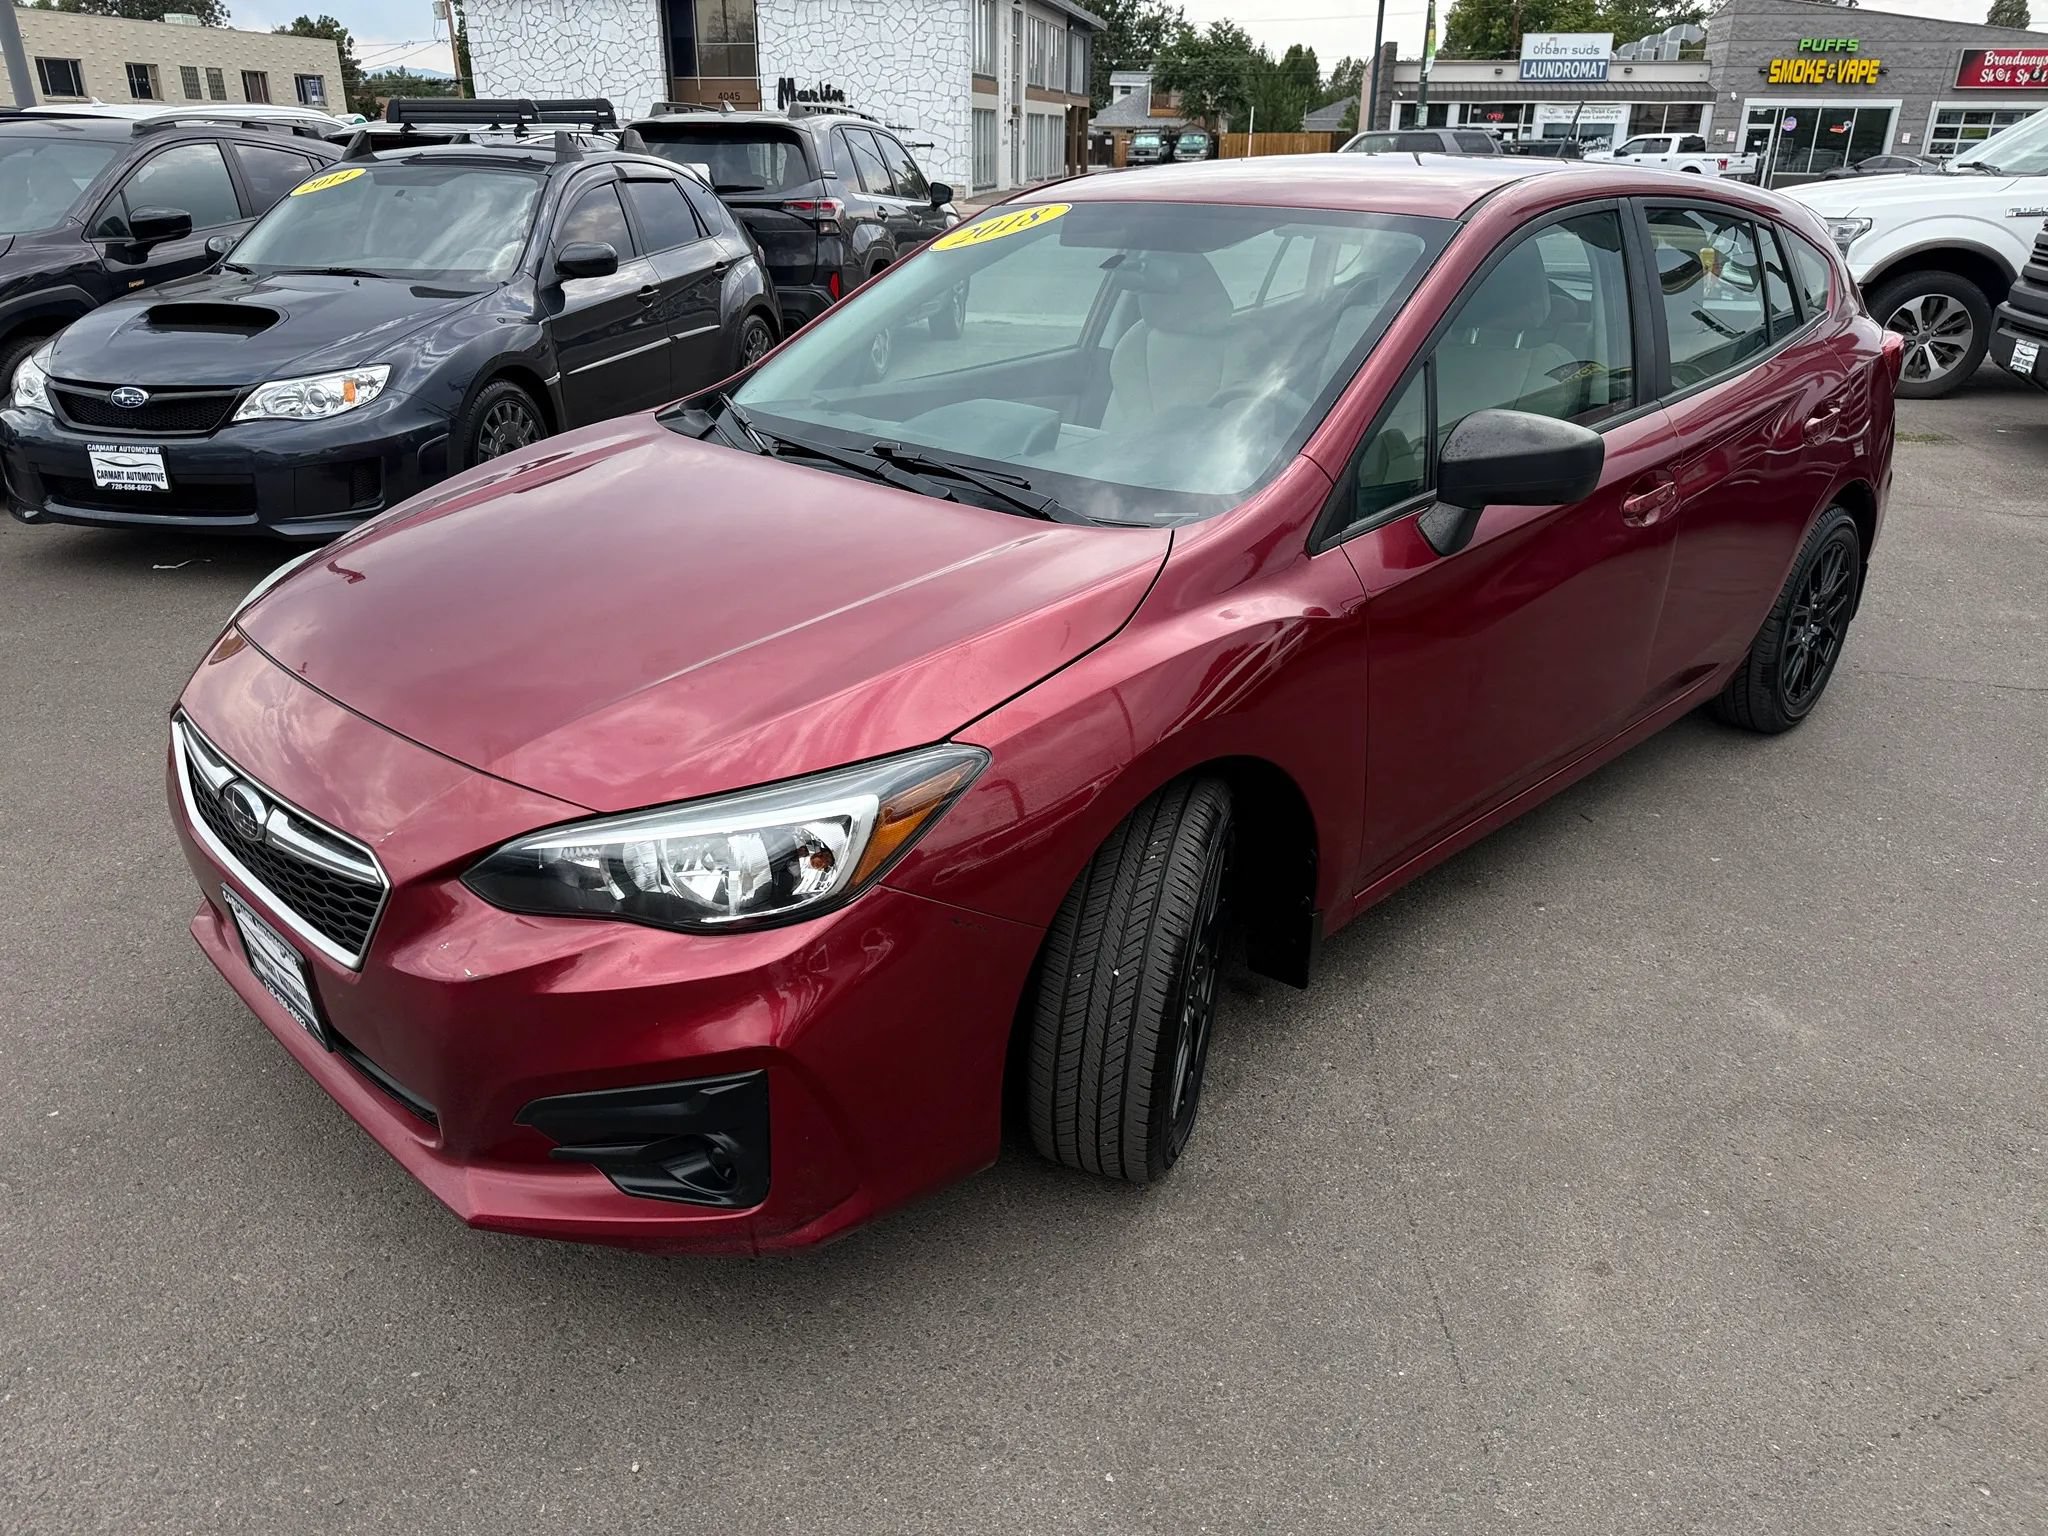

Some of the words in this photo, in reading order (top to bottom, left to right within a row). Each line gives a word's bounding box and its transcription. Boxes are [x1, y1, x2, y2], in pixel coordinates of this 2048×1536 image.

[1571, 45, 1600, 55] suds
[1799, 38, 1859, 52] PUFFS
[1522, 61, 1606, 78] LAUNDROMAT
[1768, 59, 1827, 84] SMOKE
[1826, 63, 1836, 79] &
[1836, 59, 1881, 84] VAPE
[717, 91, 741, 101] 4045
[777, 77, 845, 110] Marlin
[948, 208, 1051, 247] 2018
[87, 444, 118, 453] CARMART
[118, 445, 160, 454] AUTOMOTIVE
[96, 469, 125, 481] CARMART
[126, 471, 165, 482] AUTOMOTIVE
[111, 483, 153, 492] 720-656-6922
